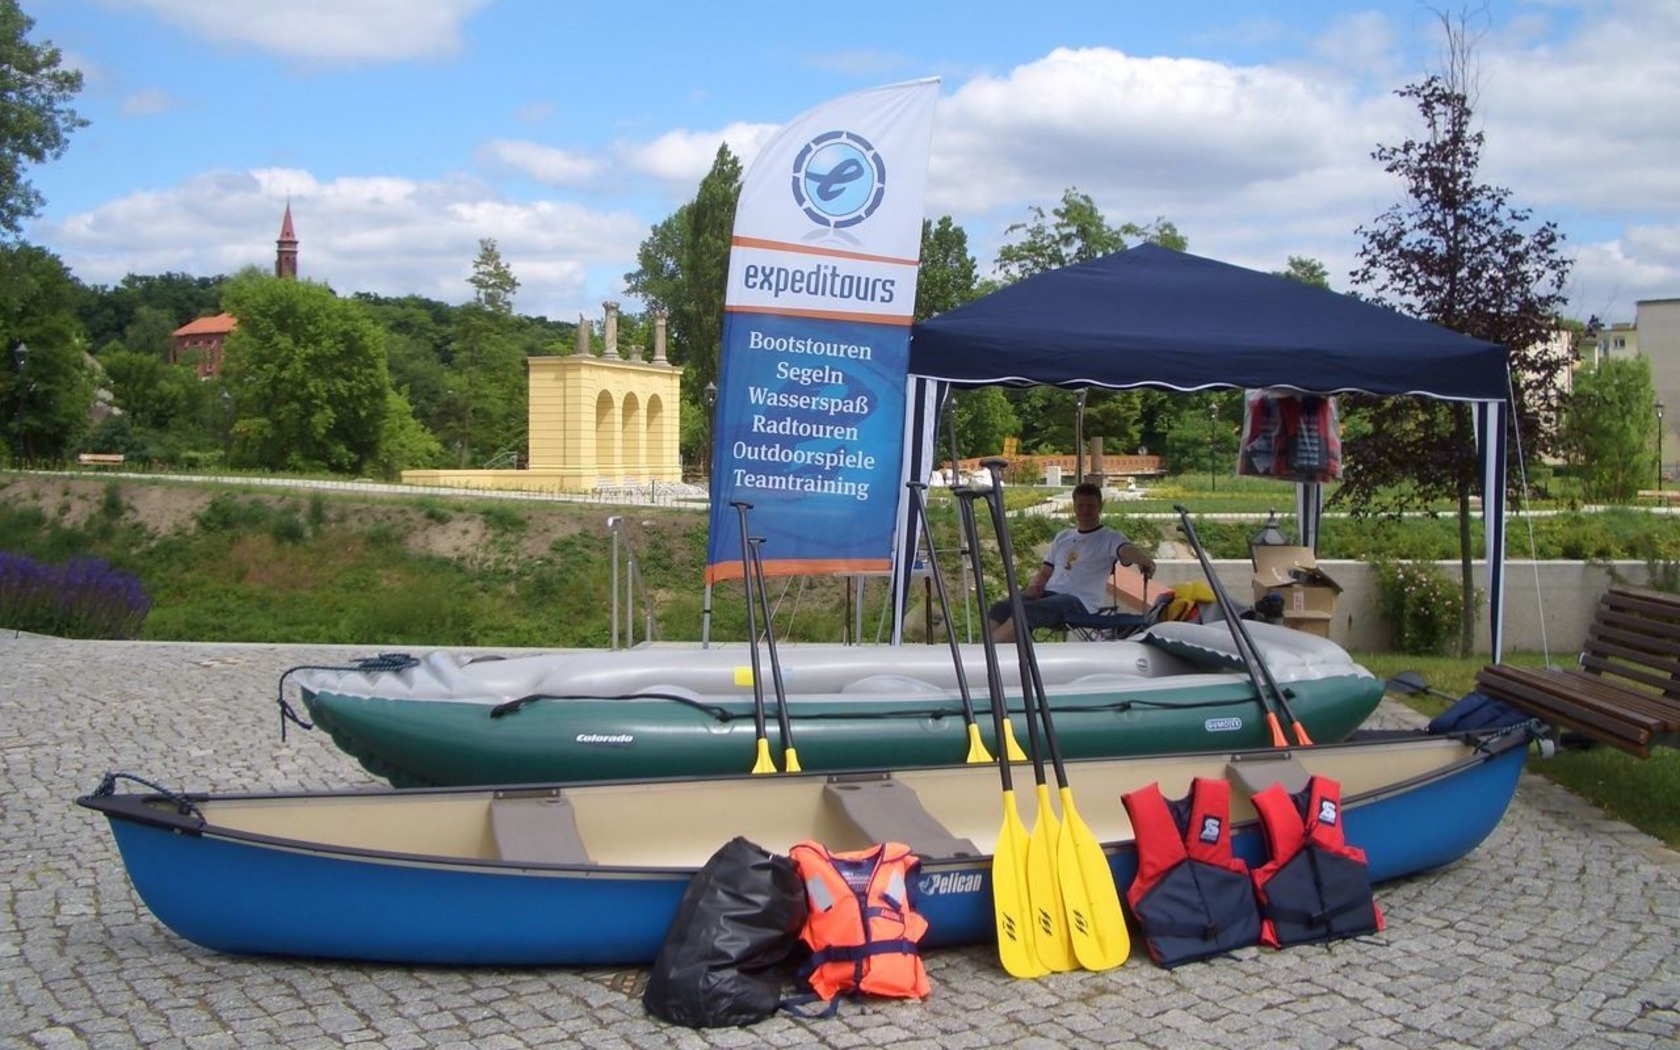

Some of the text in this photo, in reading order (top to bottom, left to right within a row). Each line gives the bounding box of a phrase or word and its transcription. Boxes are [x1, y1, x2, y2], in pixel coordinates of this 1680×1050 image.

[744, 264, 895, 303] expeditours
[749, 331, 872, 360] Bootstouren
[776, 361, 844, 385] Segeln
[749, 386, 869, 415] Wasserspaß
[752, 415, 858, 441] Radtouren
[733, 441, 875, 470] Outdoorspiele
[733, 469, 870, 500] Teamtraining
[576, 734, 634, 743] Colorado
[931, 872, 982, 894] Pelican
